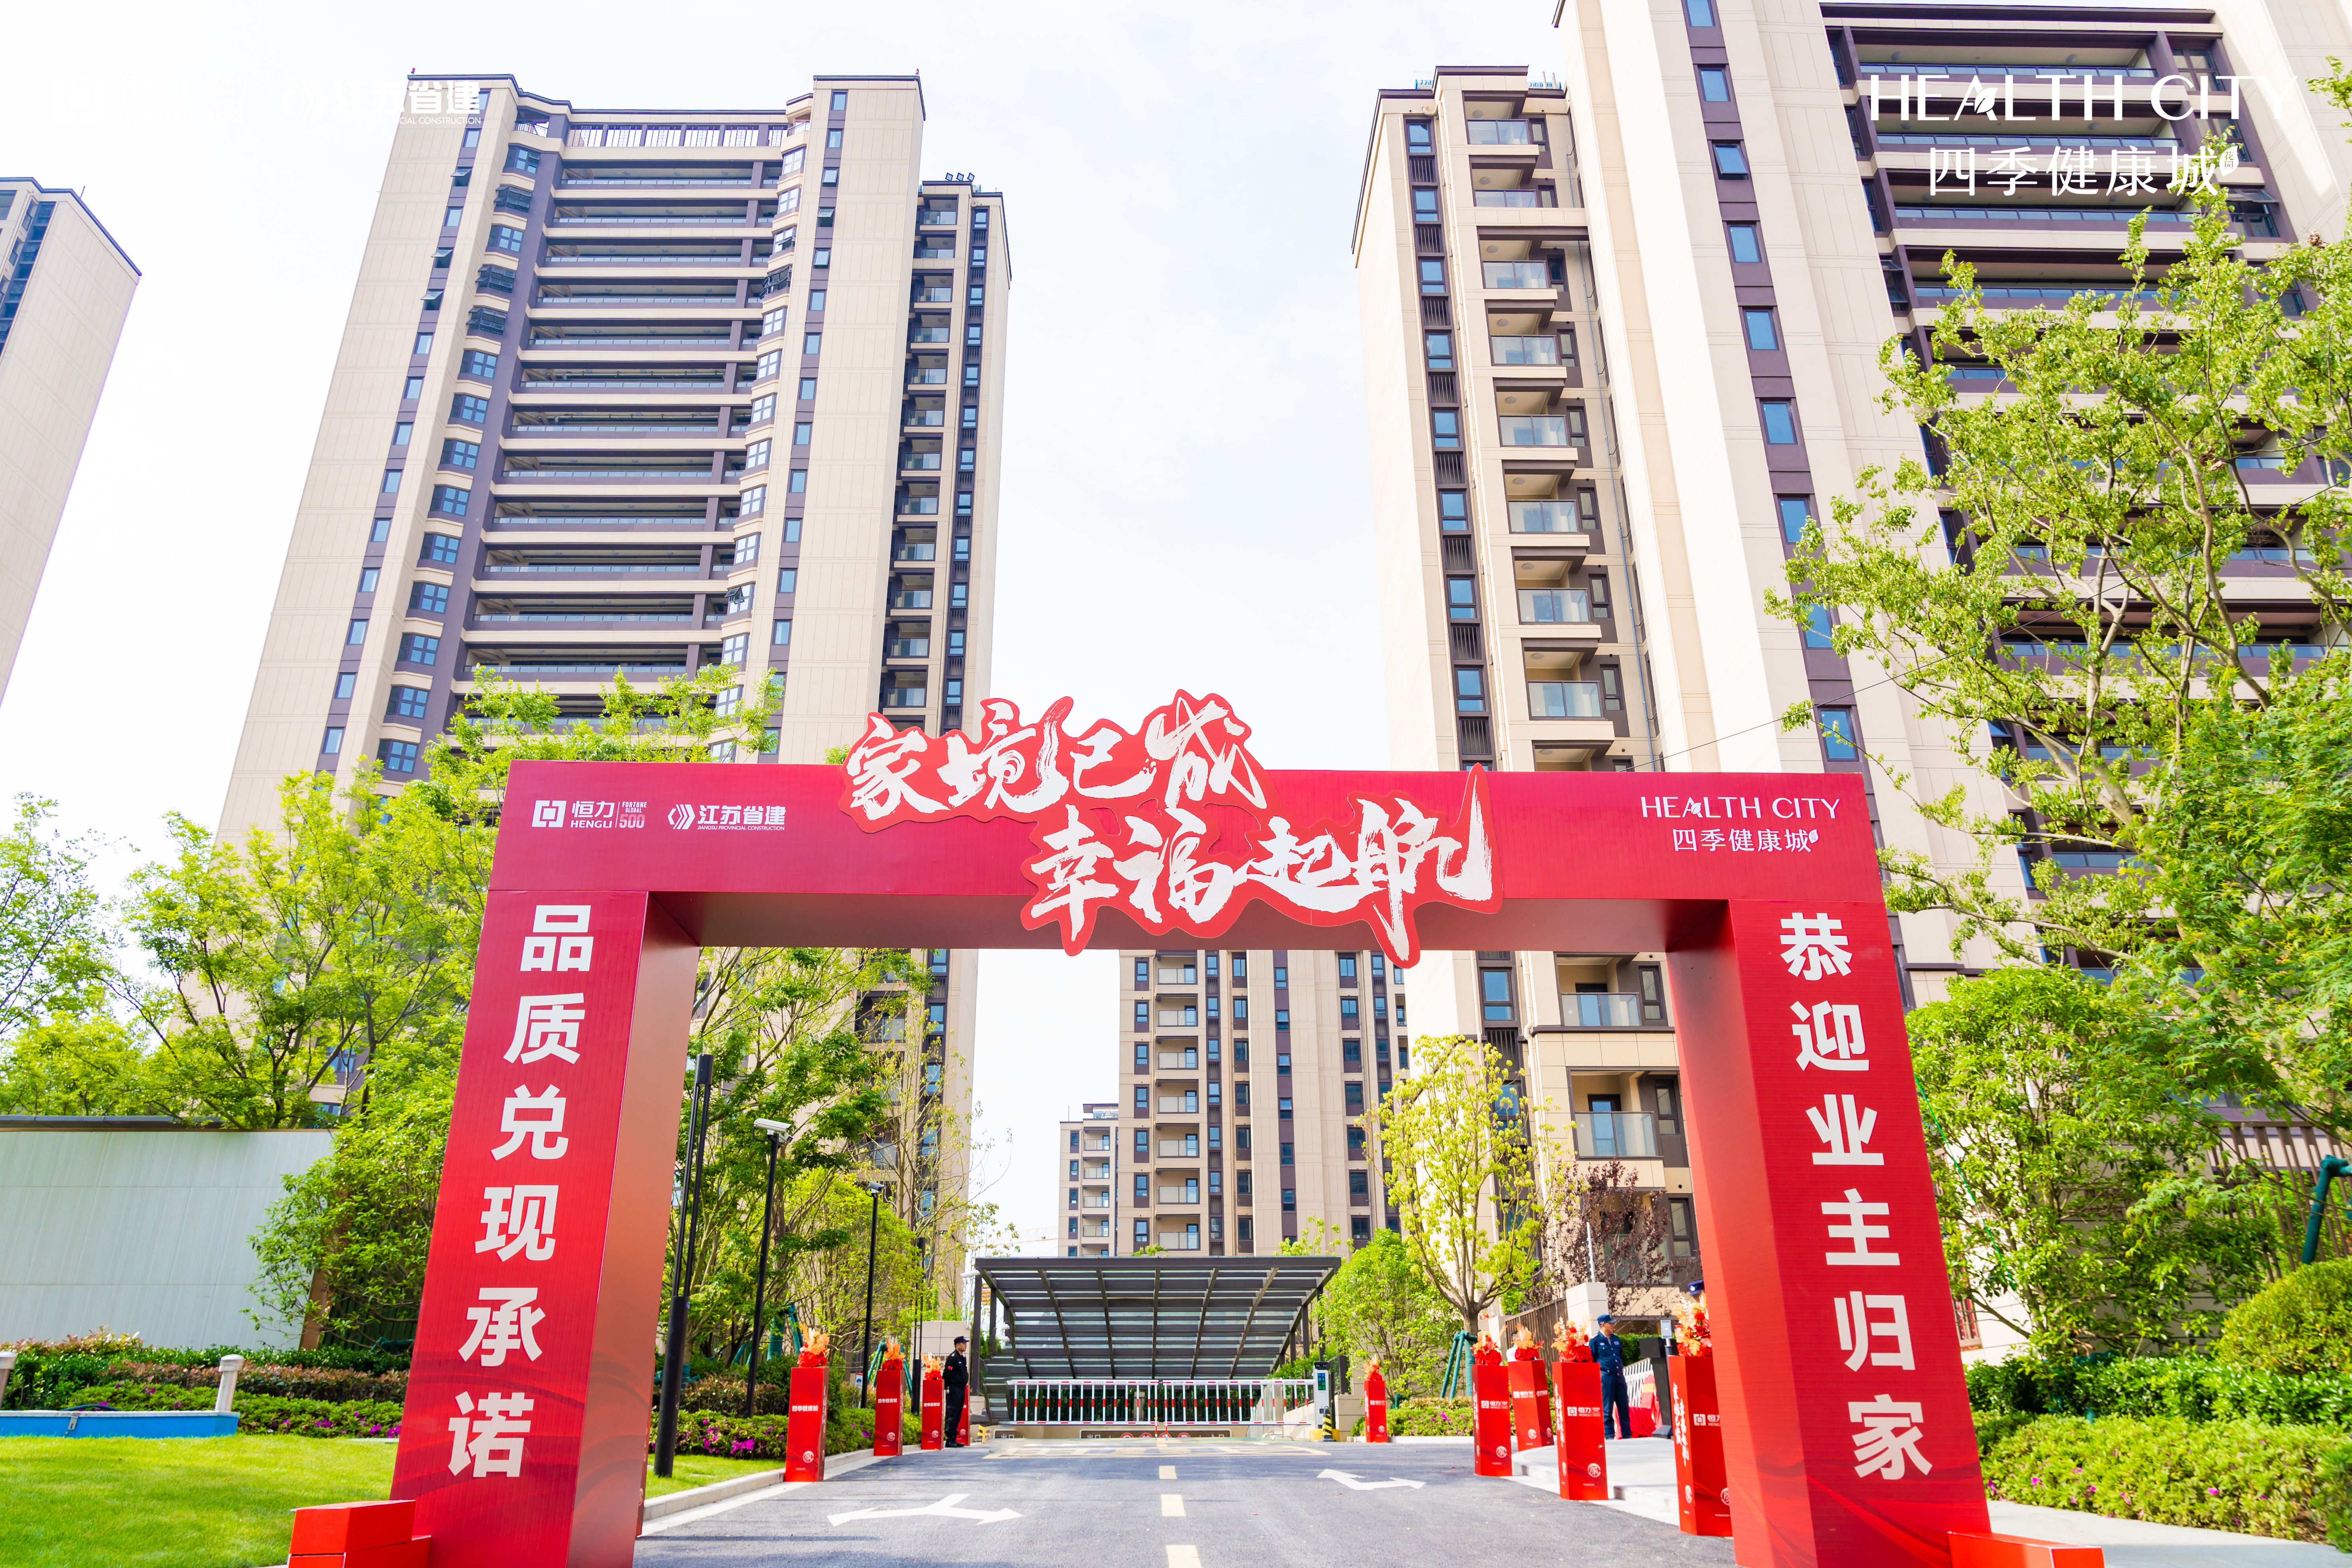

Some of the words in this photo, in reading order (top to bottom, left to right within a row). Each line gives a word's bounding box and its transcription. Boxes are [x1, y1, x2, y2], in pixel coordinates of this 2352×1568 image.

[571, 800, 615, 818] 恒力
[697, 805, 786, 825] 江苏省建
[1641, 796, 1762, 818] HEALTH
[1772, 798, 1840, 819] CITY
[619, 814, 645, 828] 500
[1673, 828, 1811, 852] 四季健康城
[448, 905, 594, 1478] 品质兑现承诺
[1780, 912, 1933, 1480] 恭迎业主归家
